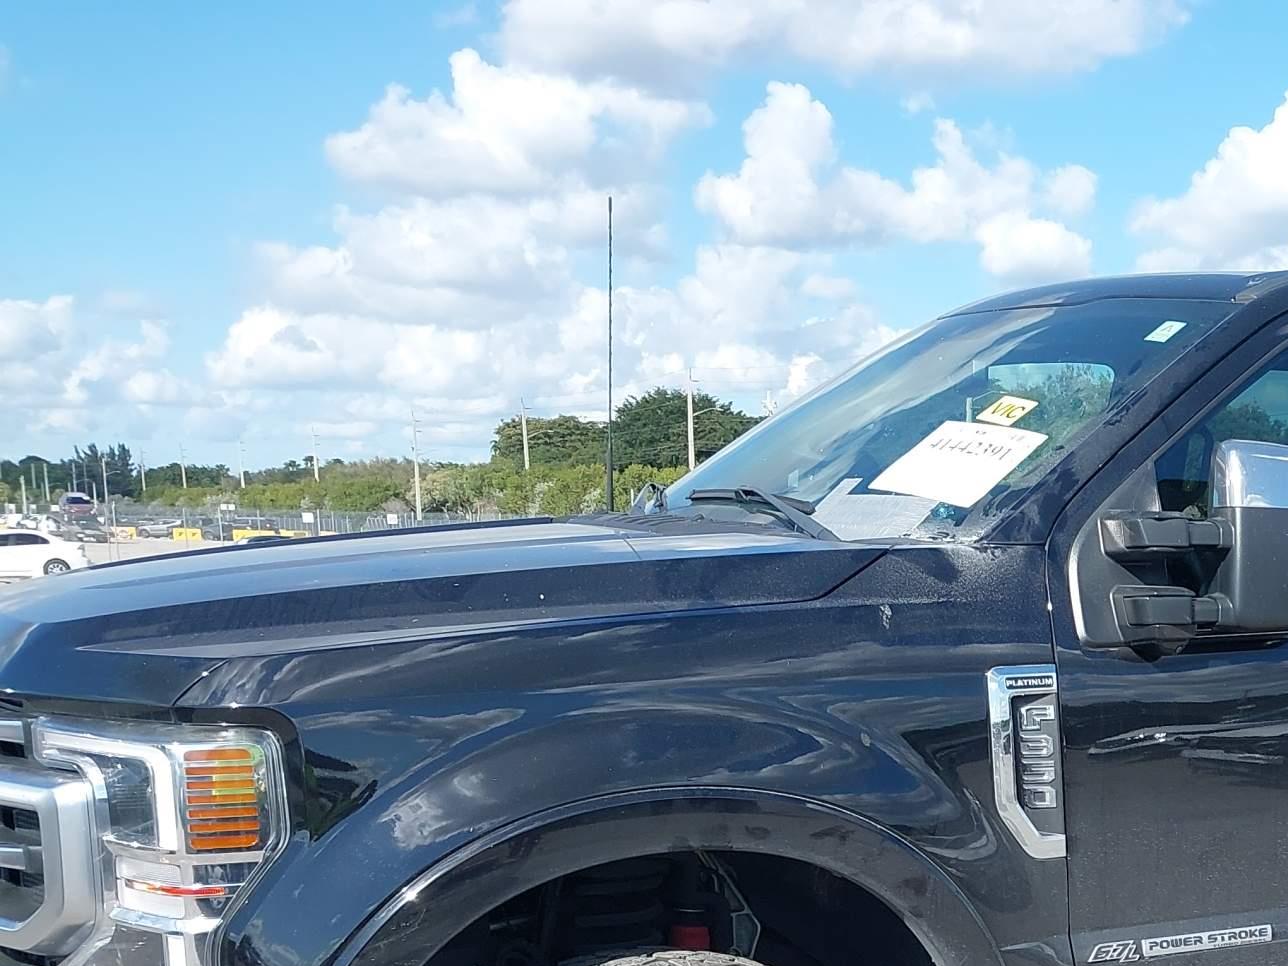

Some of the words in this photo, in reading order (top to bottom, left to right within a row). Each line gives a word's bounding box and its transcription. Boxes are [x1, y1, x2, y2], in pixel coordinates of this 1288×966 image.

[929, 438, 1012, 460] 41442391
[1005, 677, 1053, 687] PLATINUM
[1149, 935, 1204, 951] POWER
[1207, 927, 1269, 944] STROKE
